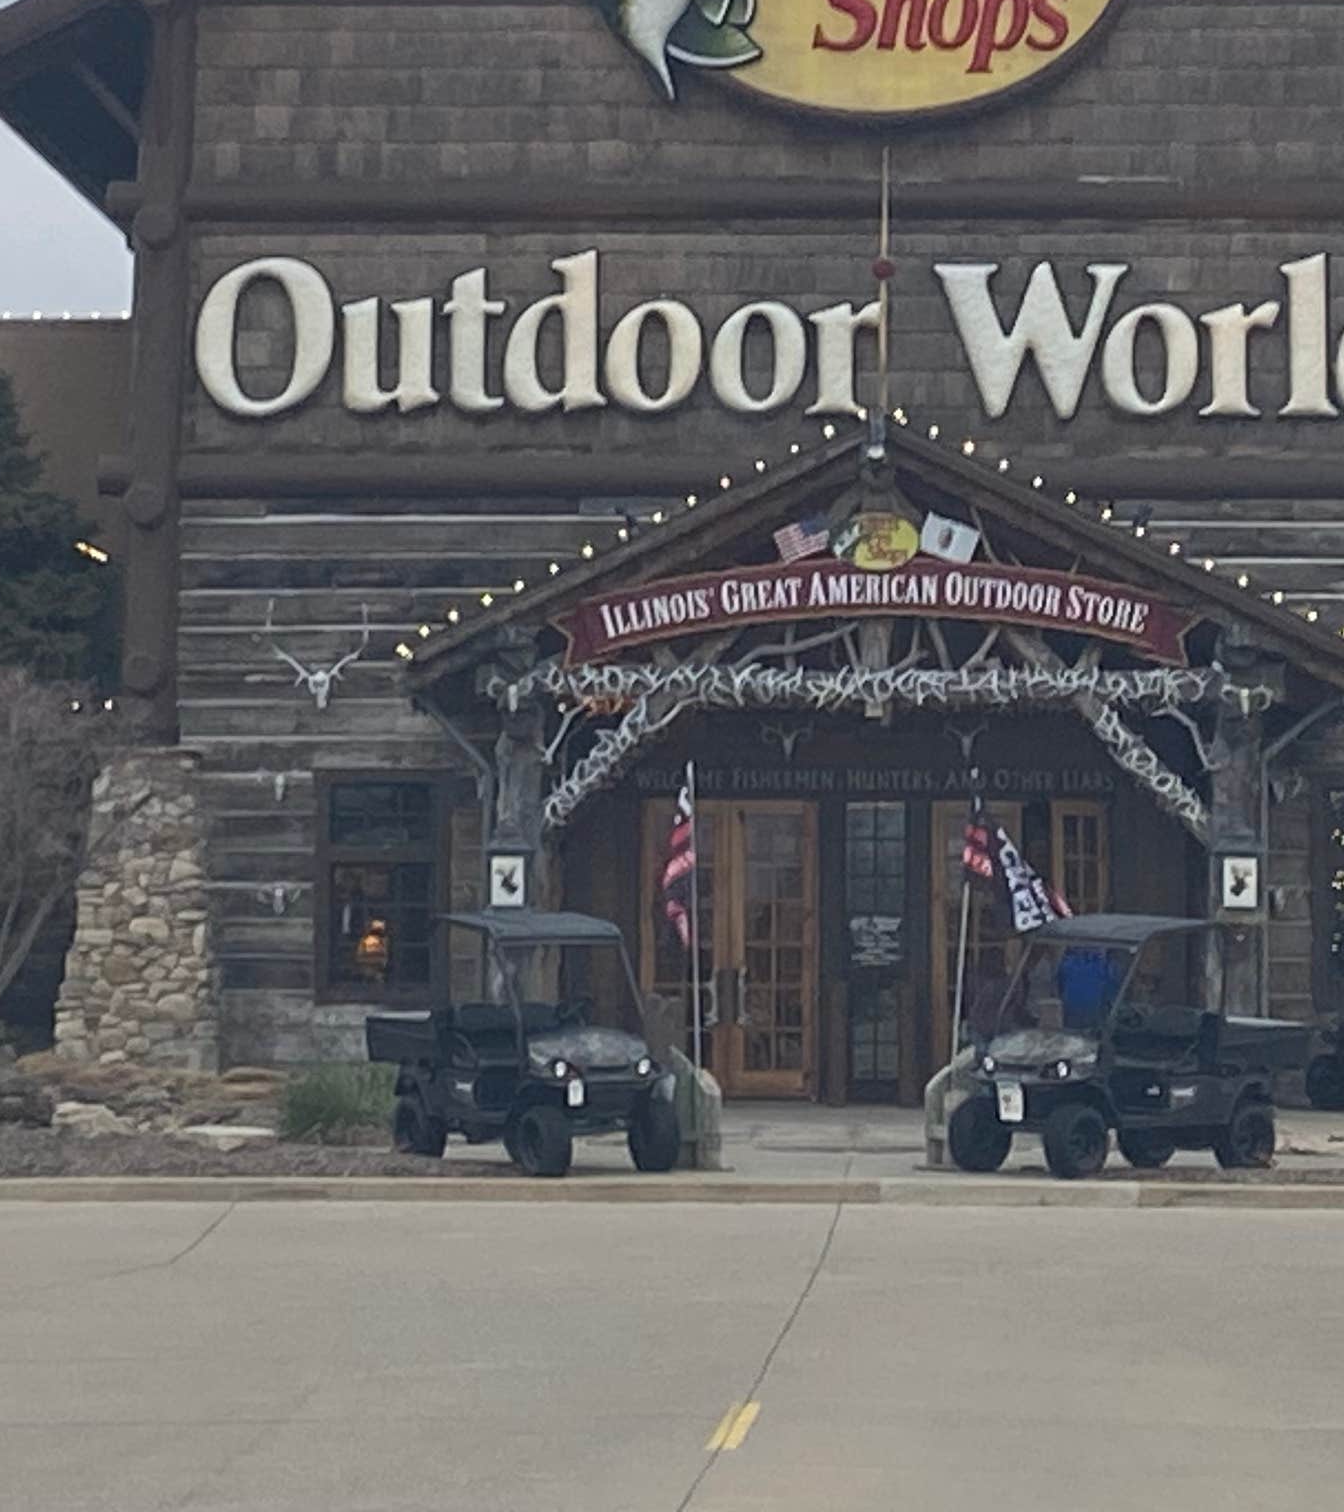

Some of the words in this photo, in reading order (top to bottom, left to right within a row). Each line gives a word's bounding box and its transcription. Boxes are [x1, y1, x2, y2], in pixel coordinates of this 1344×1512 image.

[194, 250, 883, 418] Outdoor
[719, 578, 803, 615] GREAT
[807, 570, 939, 607] AMERICAN
[943, 570, 1062, 618] OUTDOOR
[1065, 584, 1150, 635] STORE
